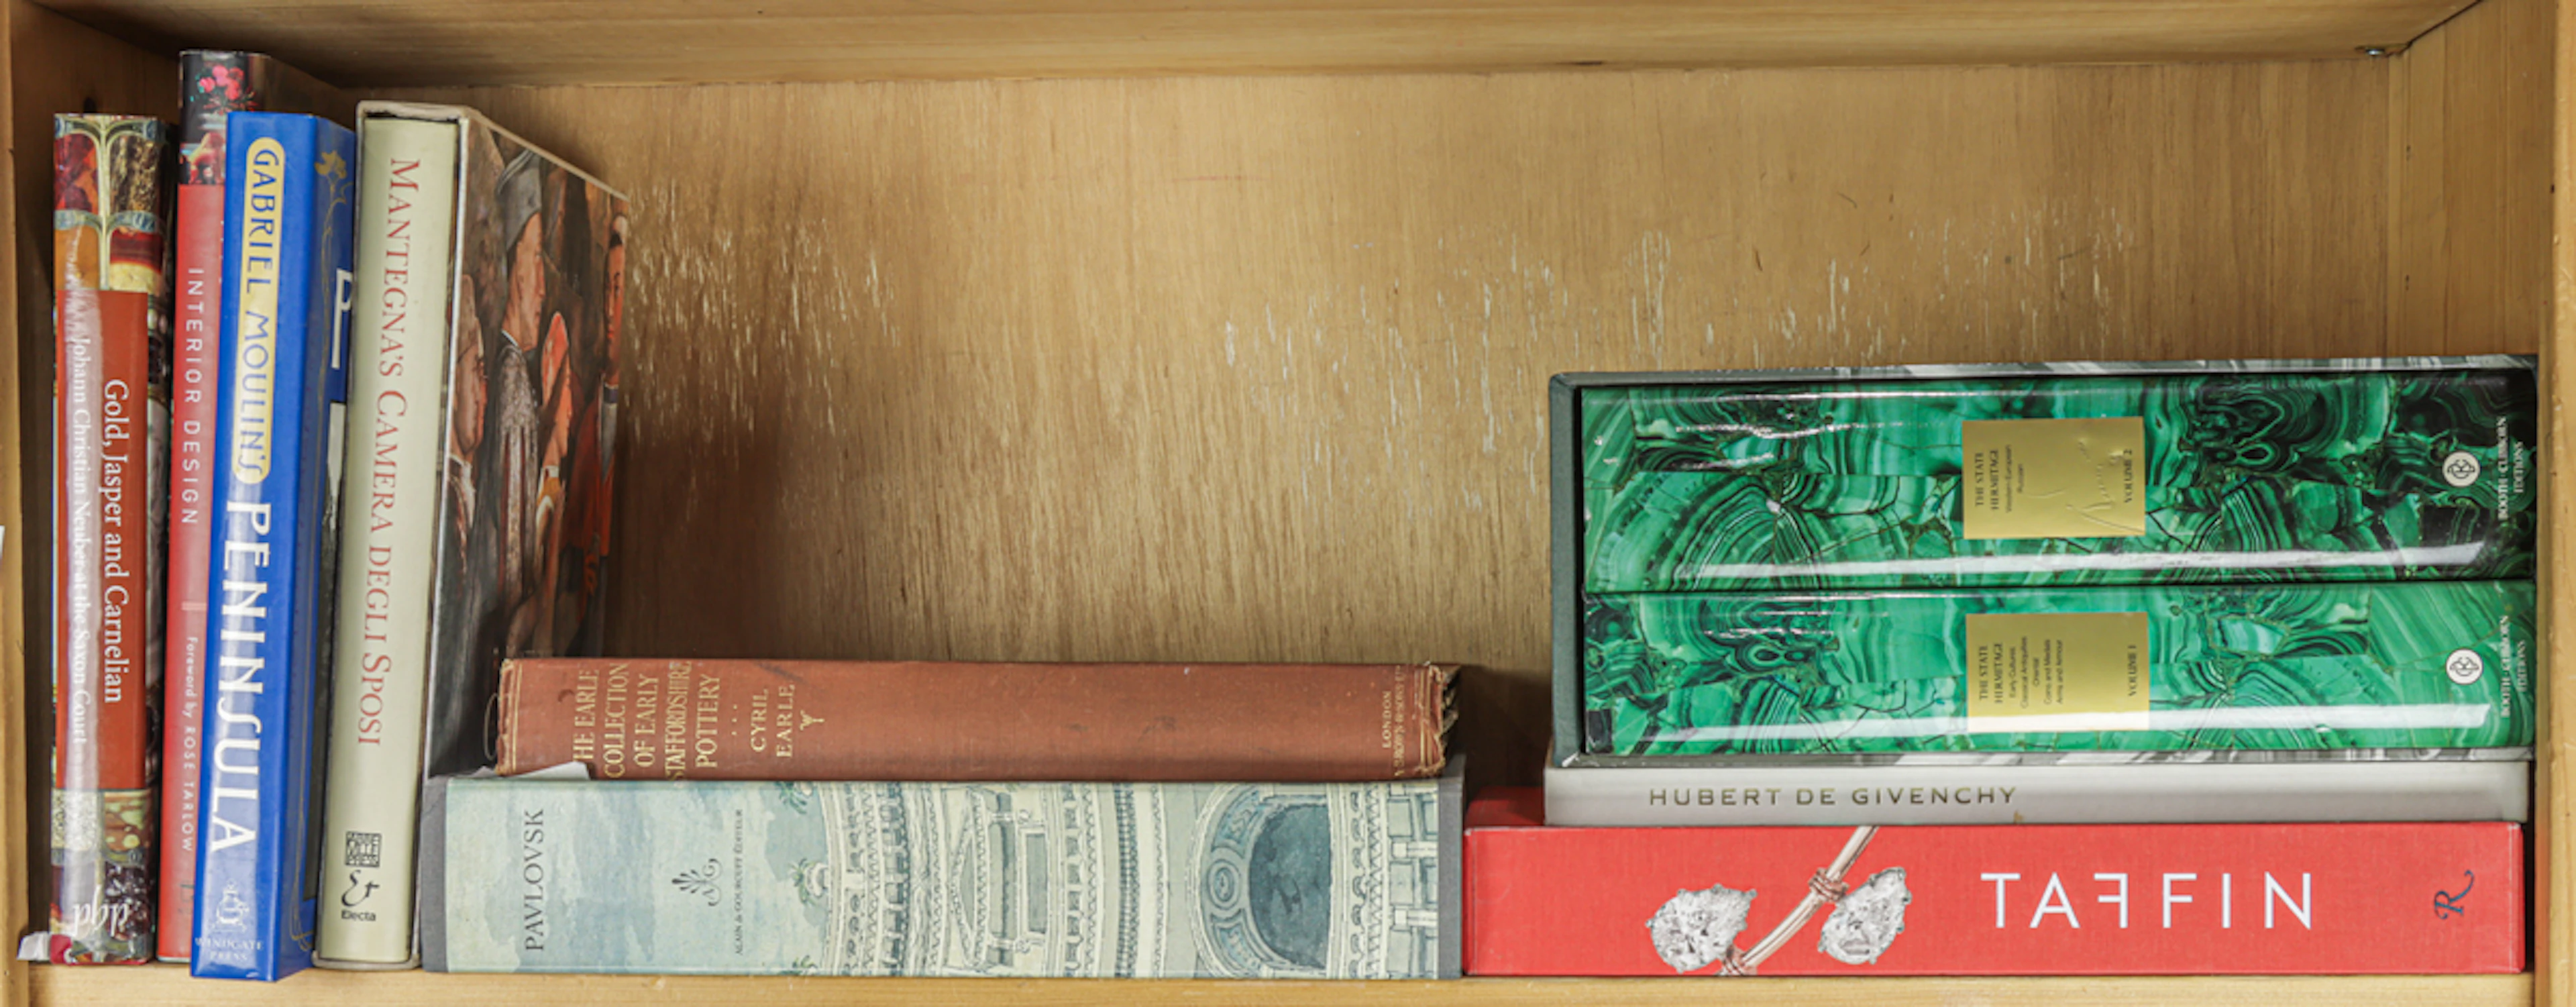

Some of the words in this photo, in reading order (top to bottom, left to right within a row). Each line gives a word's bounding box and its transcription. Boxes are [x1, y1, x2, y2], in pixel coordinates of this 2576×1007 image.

[246, 150, 282, 294] GABRIEL
[378, 158, 421, 376] MANTEGNA'S
[184, 268, 203, 402] INTERIOR
[101, 379, 129, 447] Gold,
[239, 309, 272, 474] MOULIN'S
[72, 409, 92, 493] Christian
[181, 421, 201, 524] DESIGN
[370, 390, 409, 533] CAMERA
[1975, 452, 1984, 483] STATE
[1989, 449, 1999, 511] HERMITAGE
[2123, 459, 2133, 503] VOLUME
[99, 454, 129, 526] Jasper
[1975, 487, 1984, 507] THE
[73, 501, 92, 562] Neuber
[105, 533, 129, 577] and
[74, 571, 89, 590] at
[74, 596, 92, 621] the
[364, 545, 392, 644] DEGLI
[74, 628, 92, 684] Saxon
[103, 585, 129, 703] Carnelian
[185, 636, 197, 693] Foreword
[1979, 645, 1988, 678] STATE
[1993, 642, 2003, 704] HERMITAGE
[2127, 652, 2137, 697] VOLUME
[183, 696, 196, 718] by
[211, 501, 271, 852] PENINSULA
[358, 652, 392, 745] SPOSI
[575, 669, 599, 727] EARLE
[635, 674, 659, 735] EARLY
[1979, 680, 1988, 700] THE
[74, 691, 92, 744] Court
[573, 733, 596, 762] HE
[604, 662, 629, 778] COLLECTION
[695, 674, 720, 767] POTTERY
[751, 688, 768, 751] CYRIL
[775, 684, 795, 757] EARLE
[1382, 690, 1392, 749] LONDON
[184, 727, 196, 770] ROSE
[633, 740, 655, 767] OF
[182, 781, 195, 852] TARLOW
[1650, 788, 1782, 805] HUBERT
[1796, 788, 1835, 804] DE
[1852, 786, 2017, 804] GIVENCHY
[525, 808, 545, 951] PAVLOVSK
[1980, 872, 2312, 930] TAFFIN
[2434, 869, 2475, 920] R
[341, 910, 376, 921] Electa
